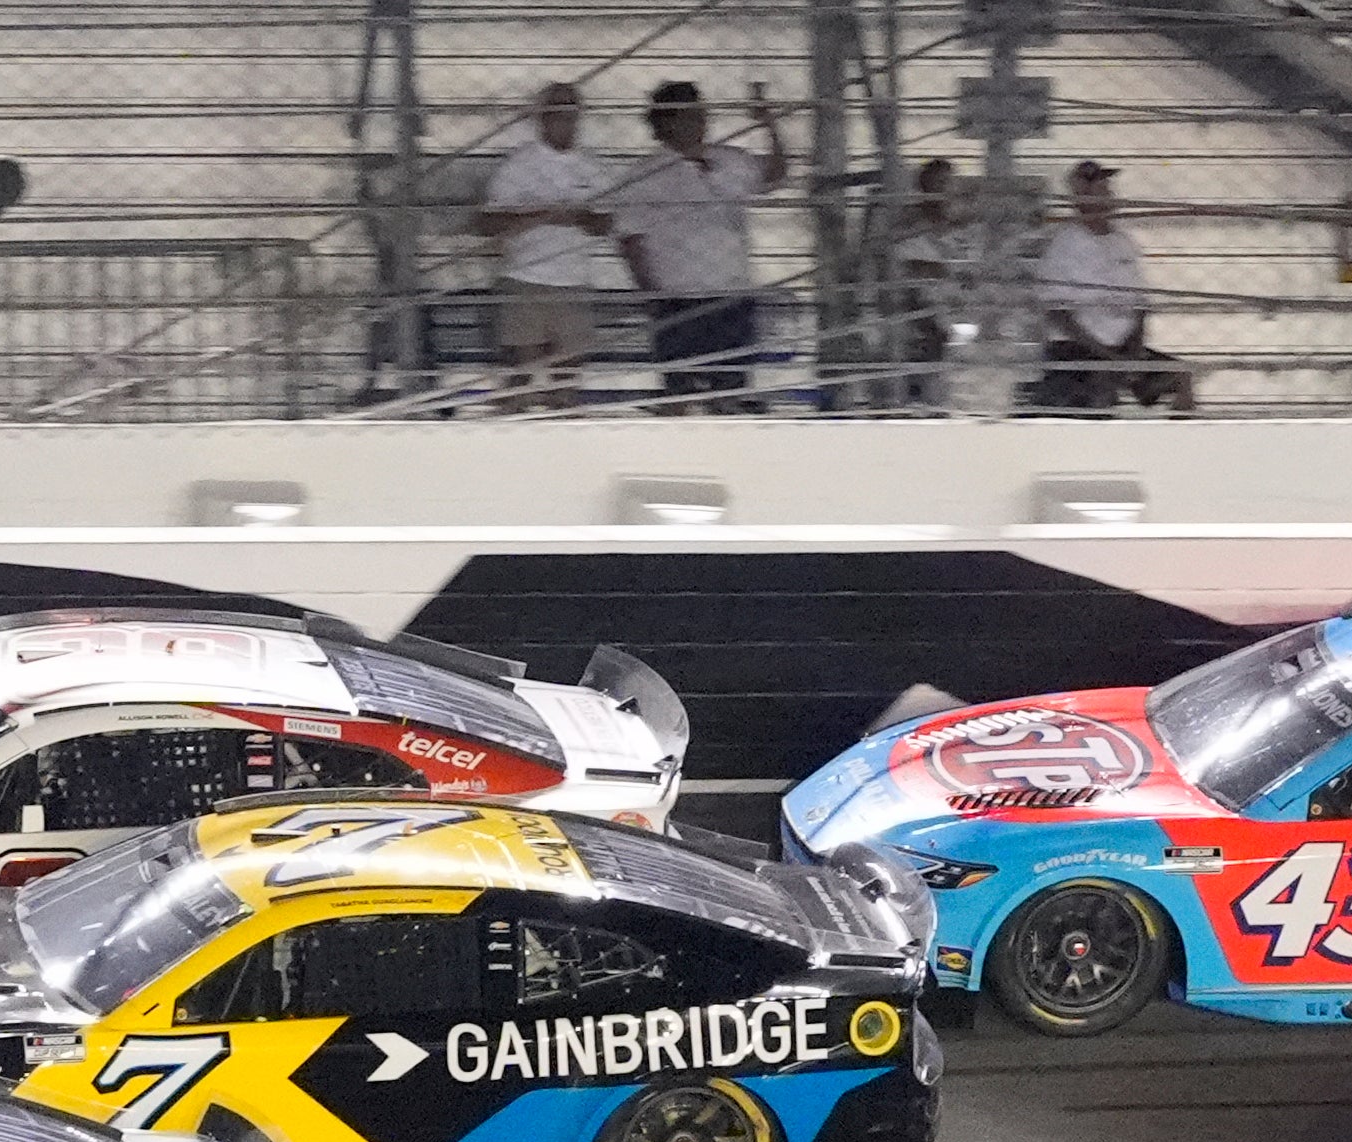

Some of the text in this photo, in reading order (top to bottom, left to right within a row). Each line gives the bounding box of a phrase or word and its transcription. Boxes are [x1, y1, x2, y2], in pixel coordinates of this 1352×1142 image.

[287, 720, 339, 737] SIEMENS
[397, 730, 488, 772] telcel
[961, 720, 1124, 793] STP
[1032, 849, 1147, 875] GOODYEAR
[446, 998, 830, 1084] GAINBRIDGE
[91, 1031, 232, 1131] 7
